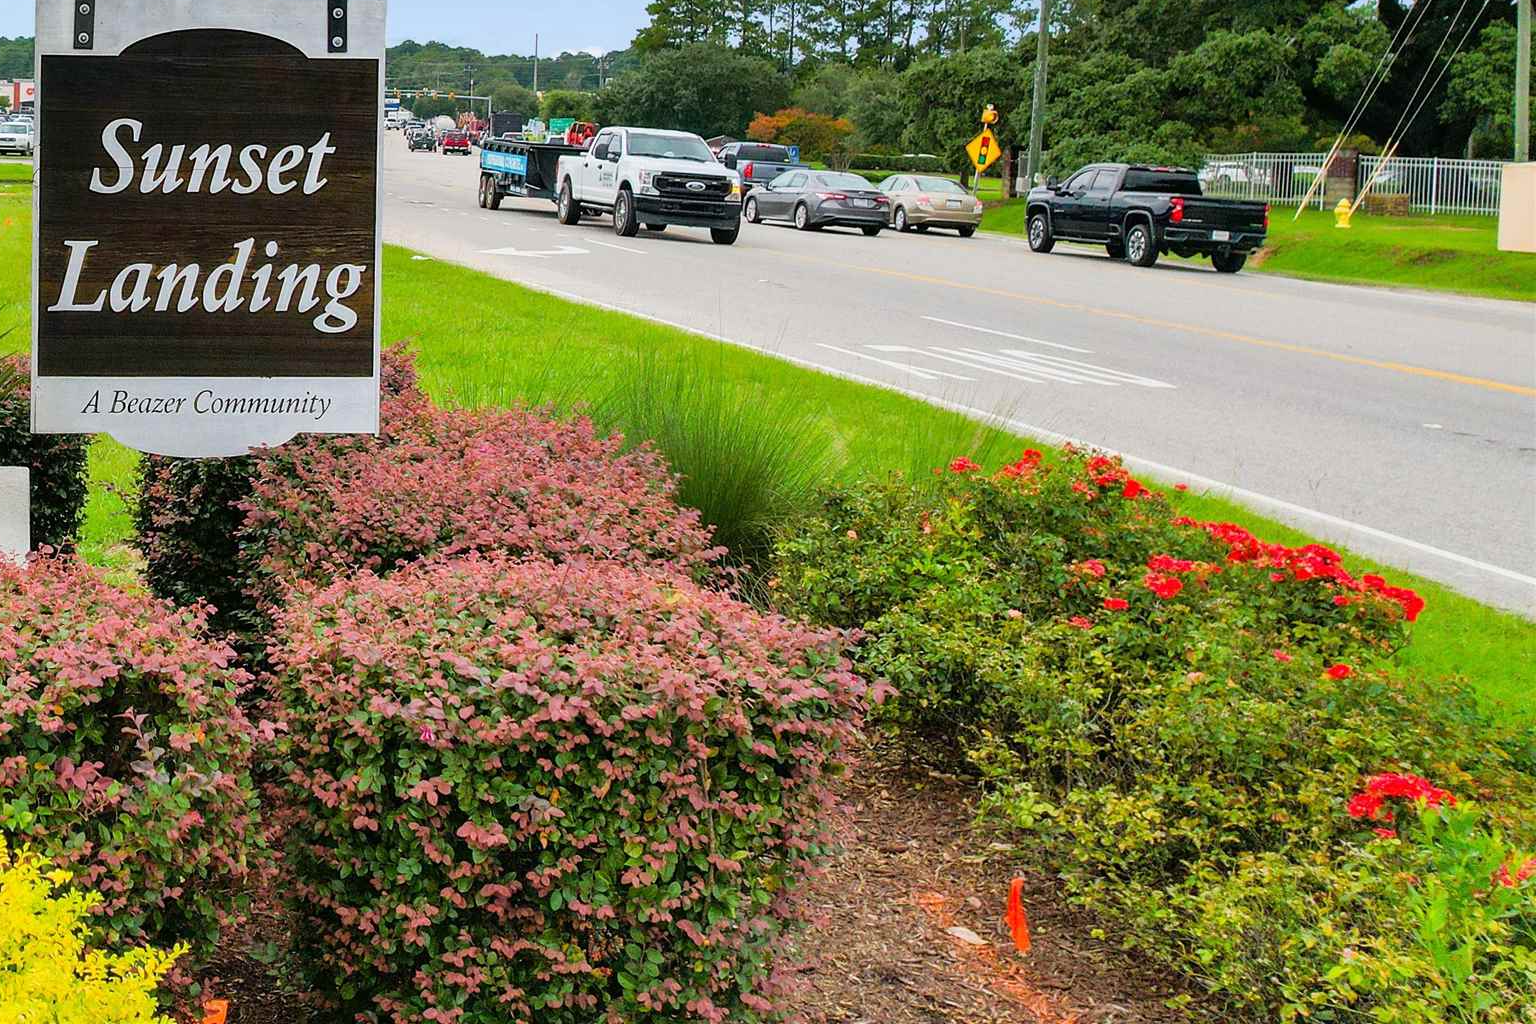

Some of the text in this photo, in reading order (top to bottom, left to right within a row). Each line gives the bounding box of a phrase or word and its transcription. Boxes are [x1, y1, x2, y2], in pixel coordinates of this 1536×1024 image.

[90, 119, 336, 194] Sunset
[48, 238, 366, 333] Landing
[81, 390, 330, 420] A Beazer Community
